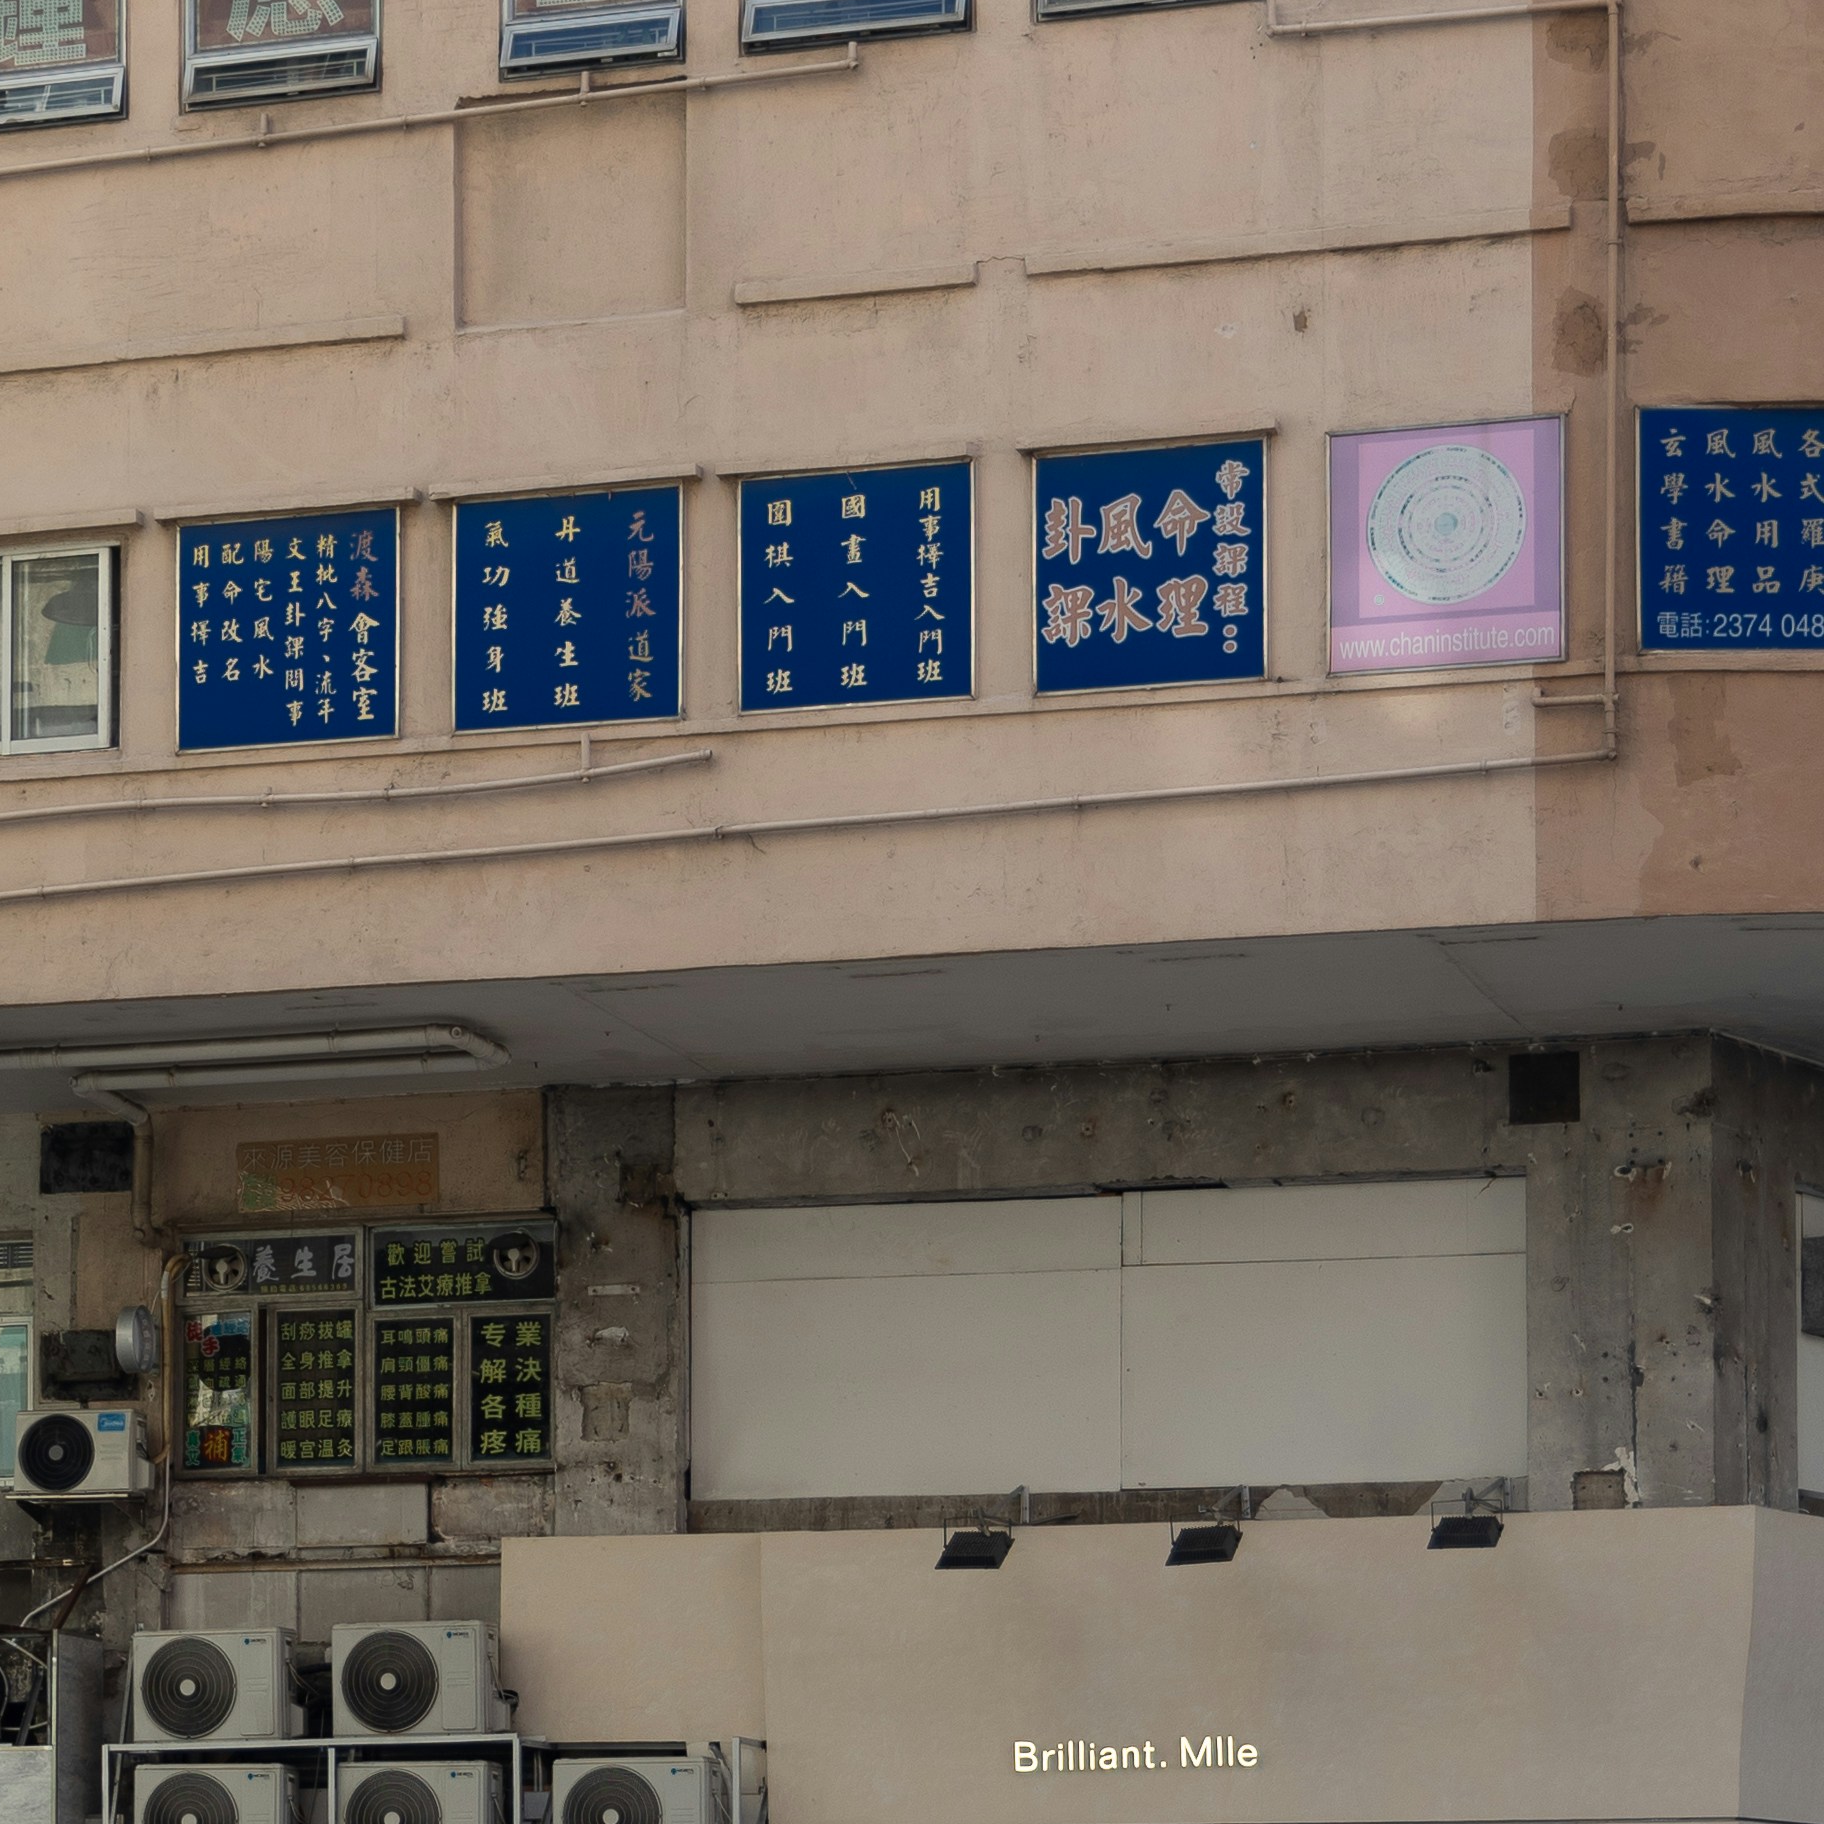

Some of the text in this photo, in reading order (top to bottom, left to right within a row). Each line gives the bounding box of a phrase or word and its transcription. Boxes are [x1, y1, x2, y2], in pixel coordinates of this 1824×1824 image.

[1658, 427, 1690, 597] 玄學書籍
[1704, 428, 1737, 596] 風水命理
[1751, 427, 1783, 596] 風水用品
[190, 545, 212, 685] 用事擇吉
[221, 543, 244, 682] 配命改名
[252, 539, 274, 681] 陽宅風水
[284, 537, 307, 727] 文王卦課問事
[481, 520, 510, 714] 氣功強身班
[625, 508, 655, 703] 元陽派道家
[764, 498, 795, 696] 圍棋入門班
[838, 493, 871, 689] 國畫入門班
[914, 486, 944, 685] 用事擇吉入門班
[1339, 622, 1556, 661] www.chaninstitute.com
[253, 1242, 355, 1284] 養生居
[379, 1271, 492, 1300] 古法艾療推拿
[280, 1349, 354, 1372] 全身推拿
[280, 1379, 354, 1401] 面部提升
[479, 1357, 542, 1385] 解決
[479, 1393, 542, 1421] 各種
[203, 1428, 229, 1463] 補
[479, 1428, 542, 1457] 疼痛
[1012, 1734, 1260, 1774] Brilliant. Mlle
